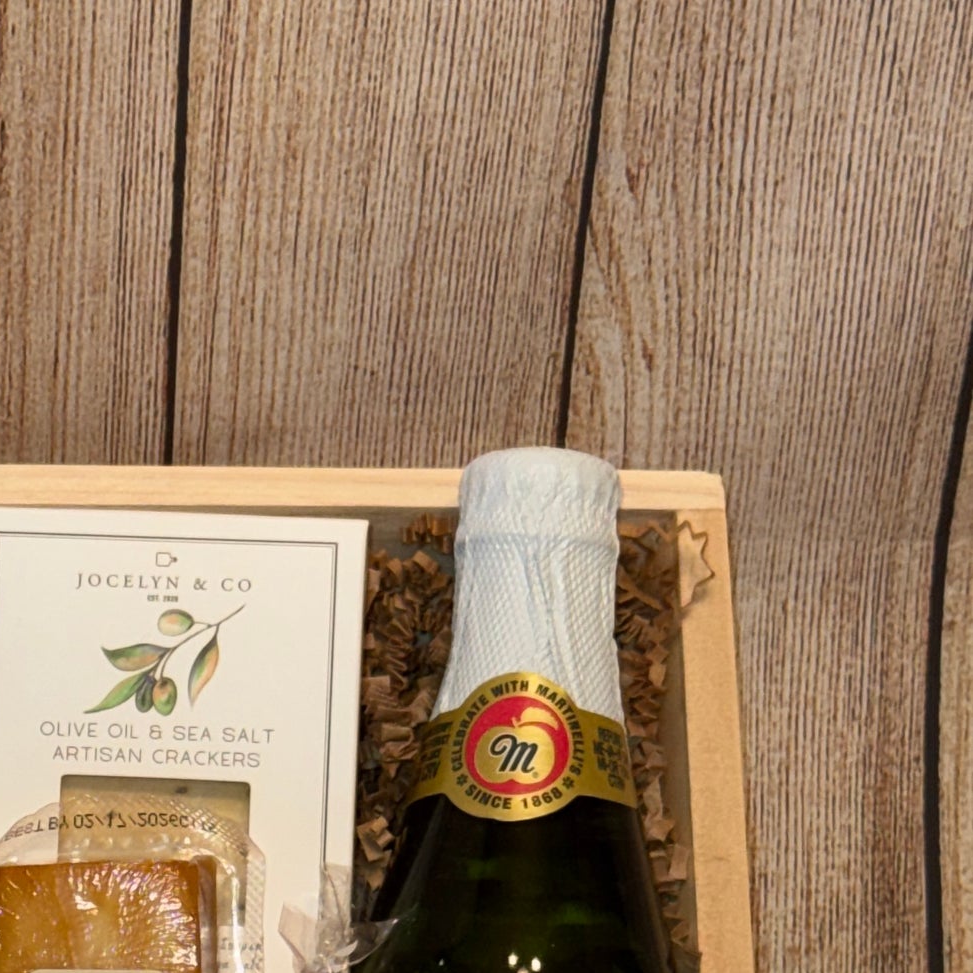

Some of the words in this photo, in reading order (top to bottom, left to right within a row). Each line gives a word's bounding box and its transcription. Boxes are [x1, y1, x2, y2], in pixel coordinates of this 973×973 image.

[75, 573, 180, 590] JOCELYN
[193, 577, 208, 592] &
[220, 577, 253, 593] CO
[40, 721, 98, 738] OLIVE
[107, 722, 138, 740] OIL
[149, 724, 163, 740] &
[172, 725, 212, 742] SEA
[222, 727, 276, 745] SALT
[490, 680, 529, 698] WITH
[534, 683, 586, 775] MARTINELLI'S
[52, 746, 142, 764] ARTISAN
[152, 749, 261, 768] CRACKERS
[464, 784, 513, 810] SINCE
[520, 786, 564, 810] 1868
